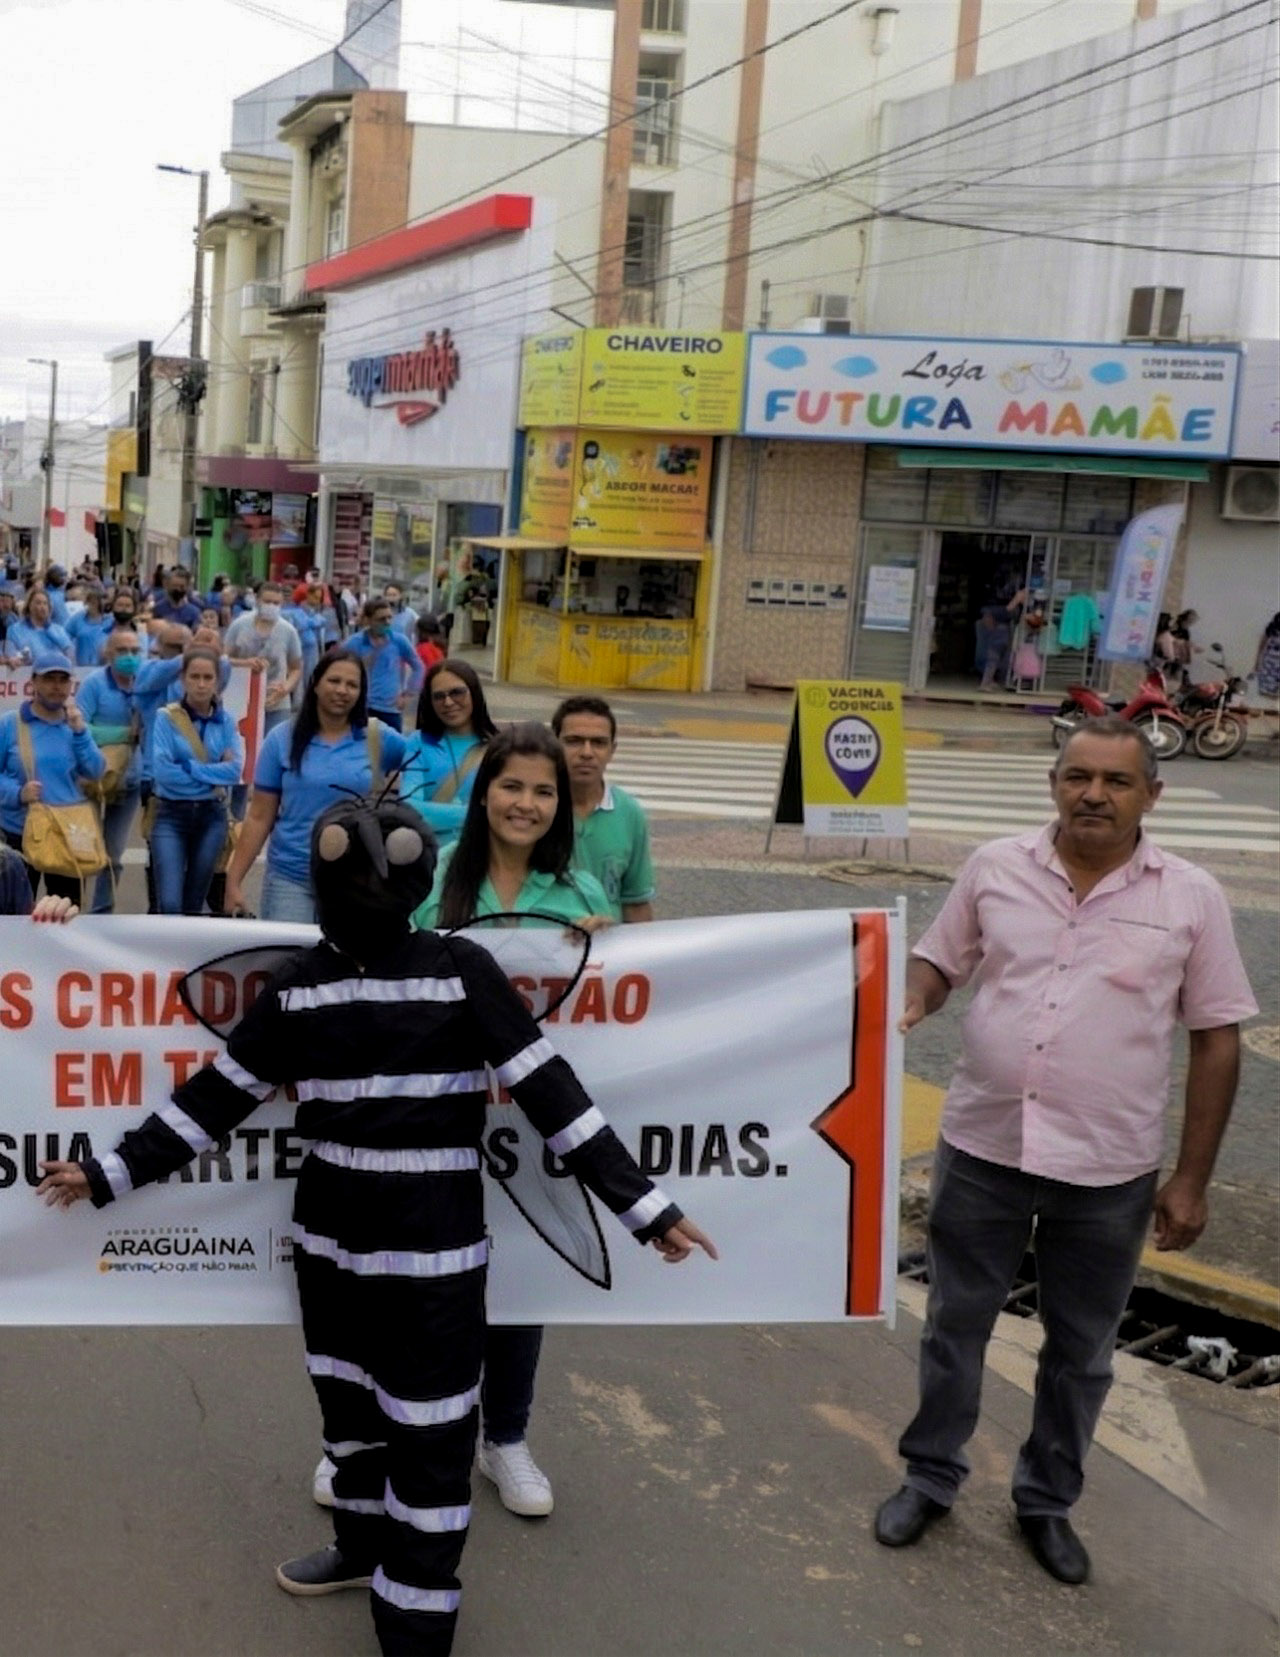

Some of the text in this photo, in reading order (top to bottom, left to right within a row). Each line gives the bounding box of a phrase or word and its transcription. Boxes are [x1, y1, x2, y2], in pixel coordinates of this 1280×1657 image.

[607, 334, 723, 354] CHAVEIRO
[902, 351, 987, 388] Loja
[764, 389, 972, 430] FUTURA
[997, 393, 1216, 441] MAMÃE
[828, 688, 884, 698] VACINA
[55, 1052, 143, 1108] EM
[640, 1122, 789, 1178] DIAS.
